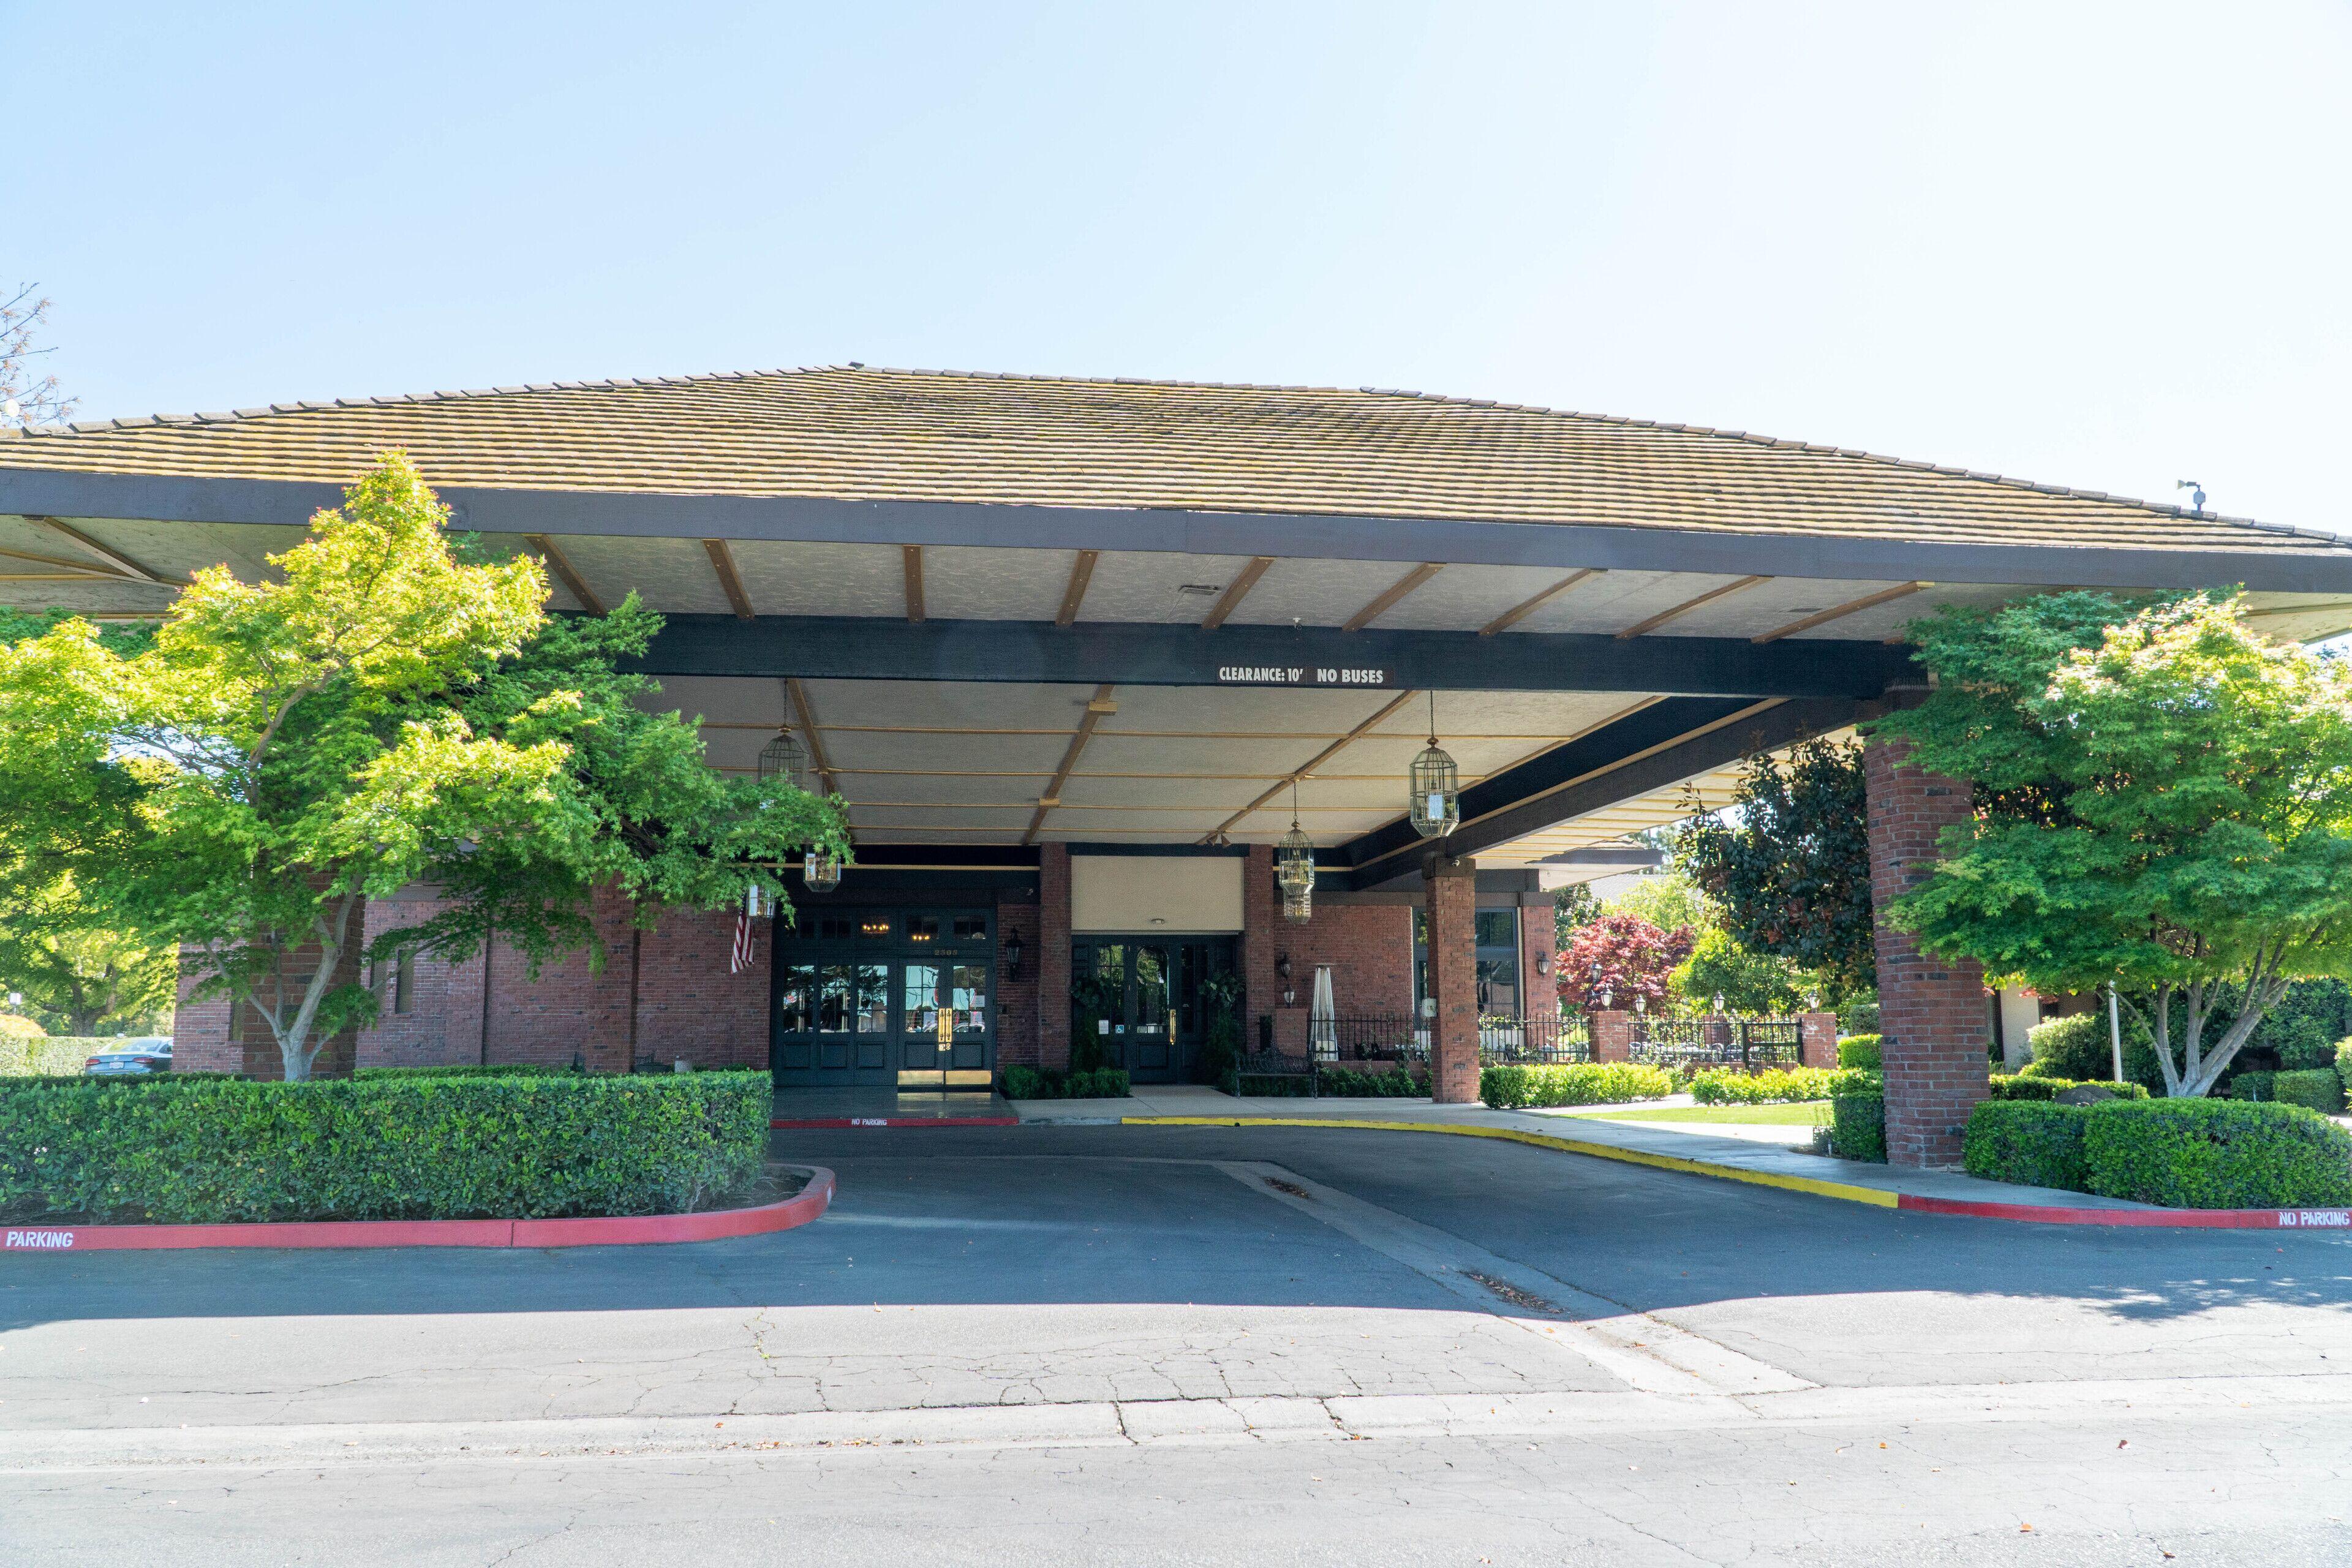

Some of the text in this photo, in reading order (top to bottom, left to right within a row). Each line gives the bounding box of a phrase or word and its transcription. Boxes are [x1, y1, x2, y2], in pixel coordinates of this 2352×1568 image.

[1219, 667, 1285, 682] CLEARANCE:
[1317, 668, 1383, 684] NO BUSES
[2279, 1212, 2350, 1226] NO PARKING
[6, 1231, 74, 1248] PARKING
